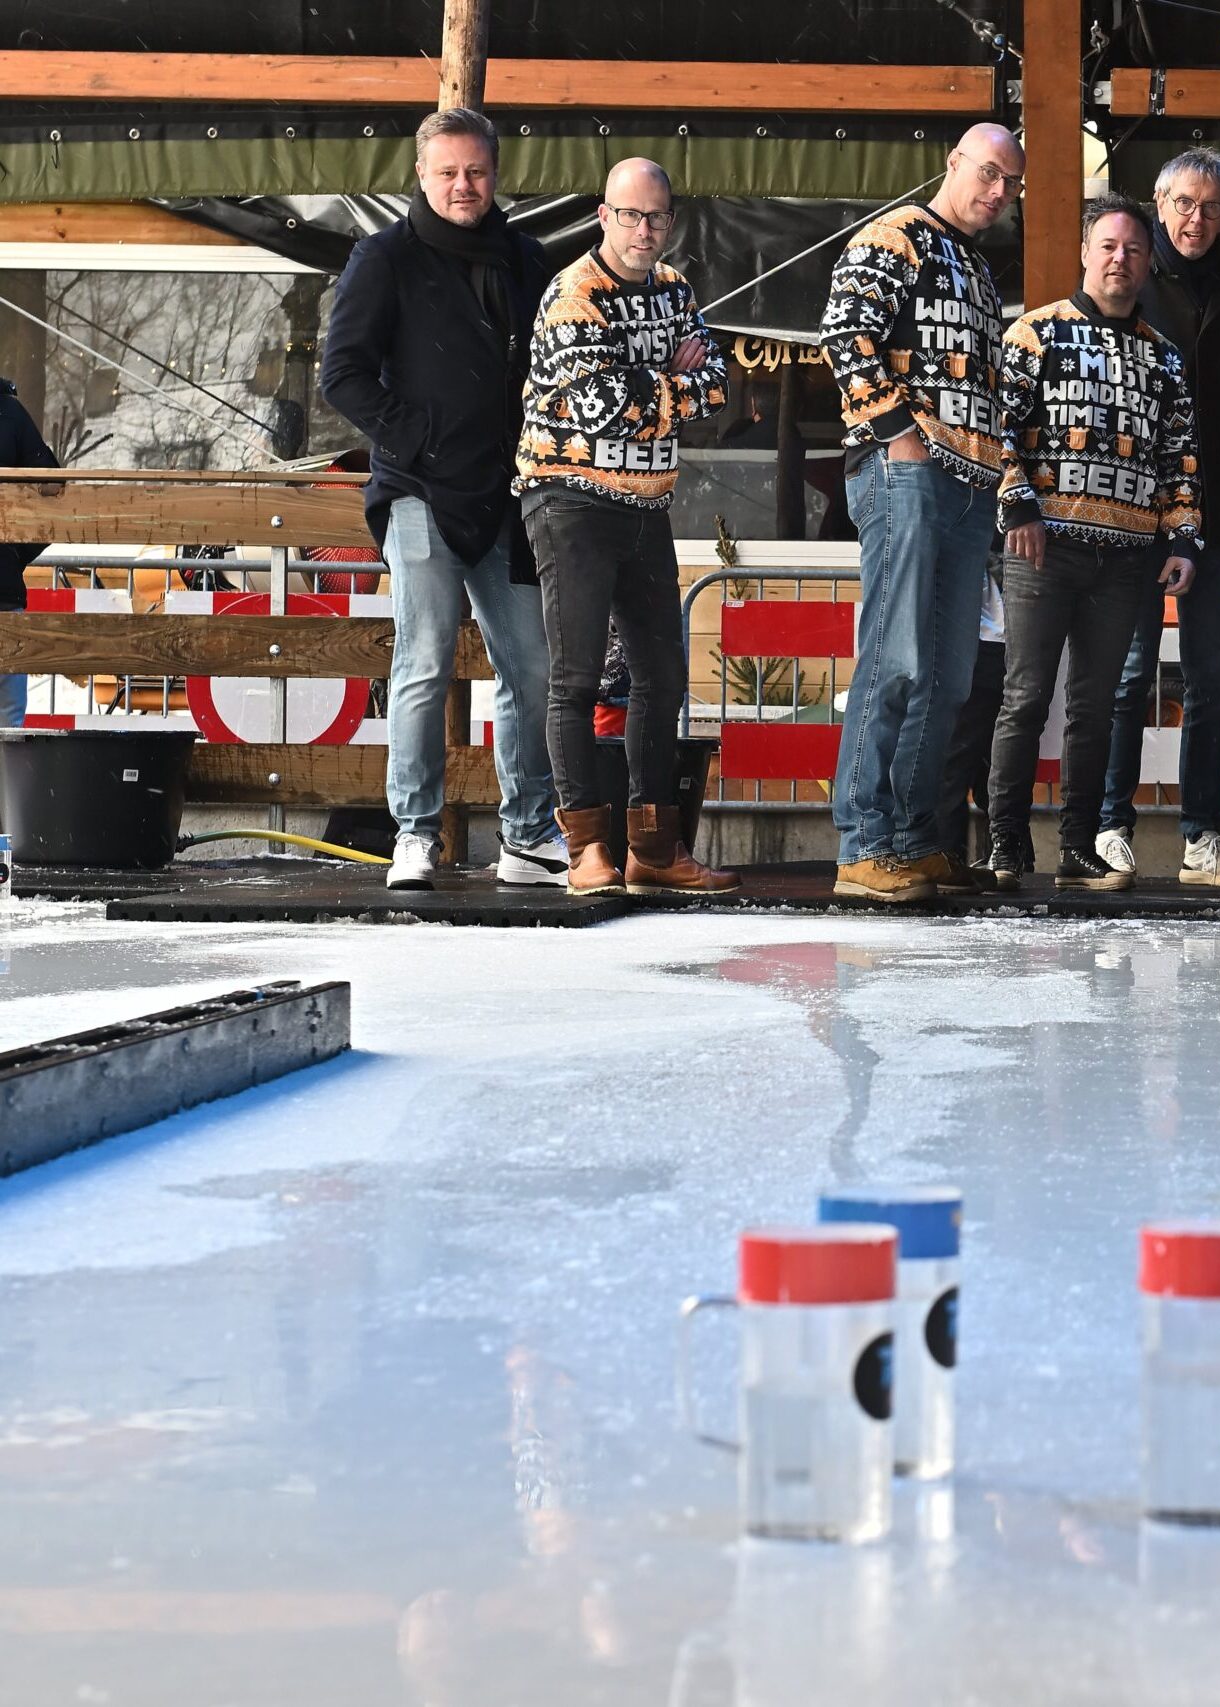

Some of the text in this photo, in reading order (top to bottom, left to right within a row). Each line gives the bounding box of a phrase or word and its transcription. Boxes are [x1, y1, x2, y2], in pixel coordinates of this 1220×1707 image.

[917, 325, 980, 358] TIME
[1071, 325, 1157, 363] IT'S THE
[1079, 350, 1149, 393] MOST
[1046, 404, 1107, 429] TIME
[1058, 462, 1156, 507] BEER
